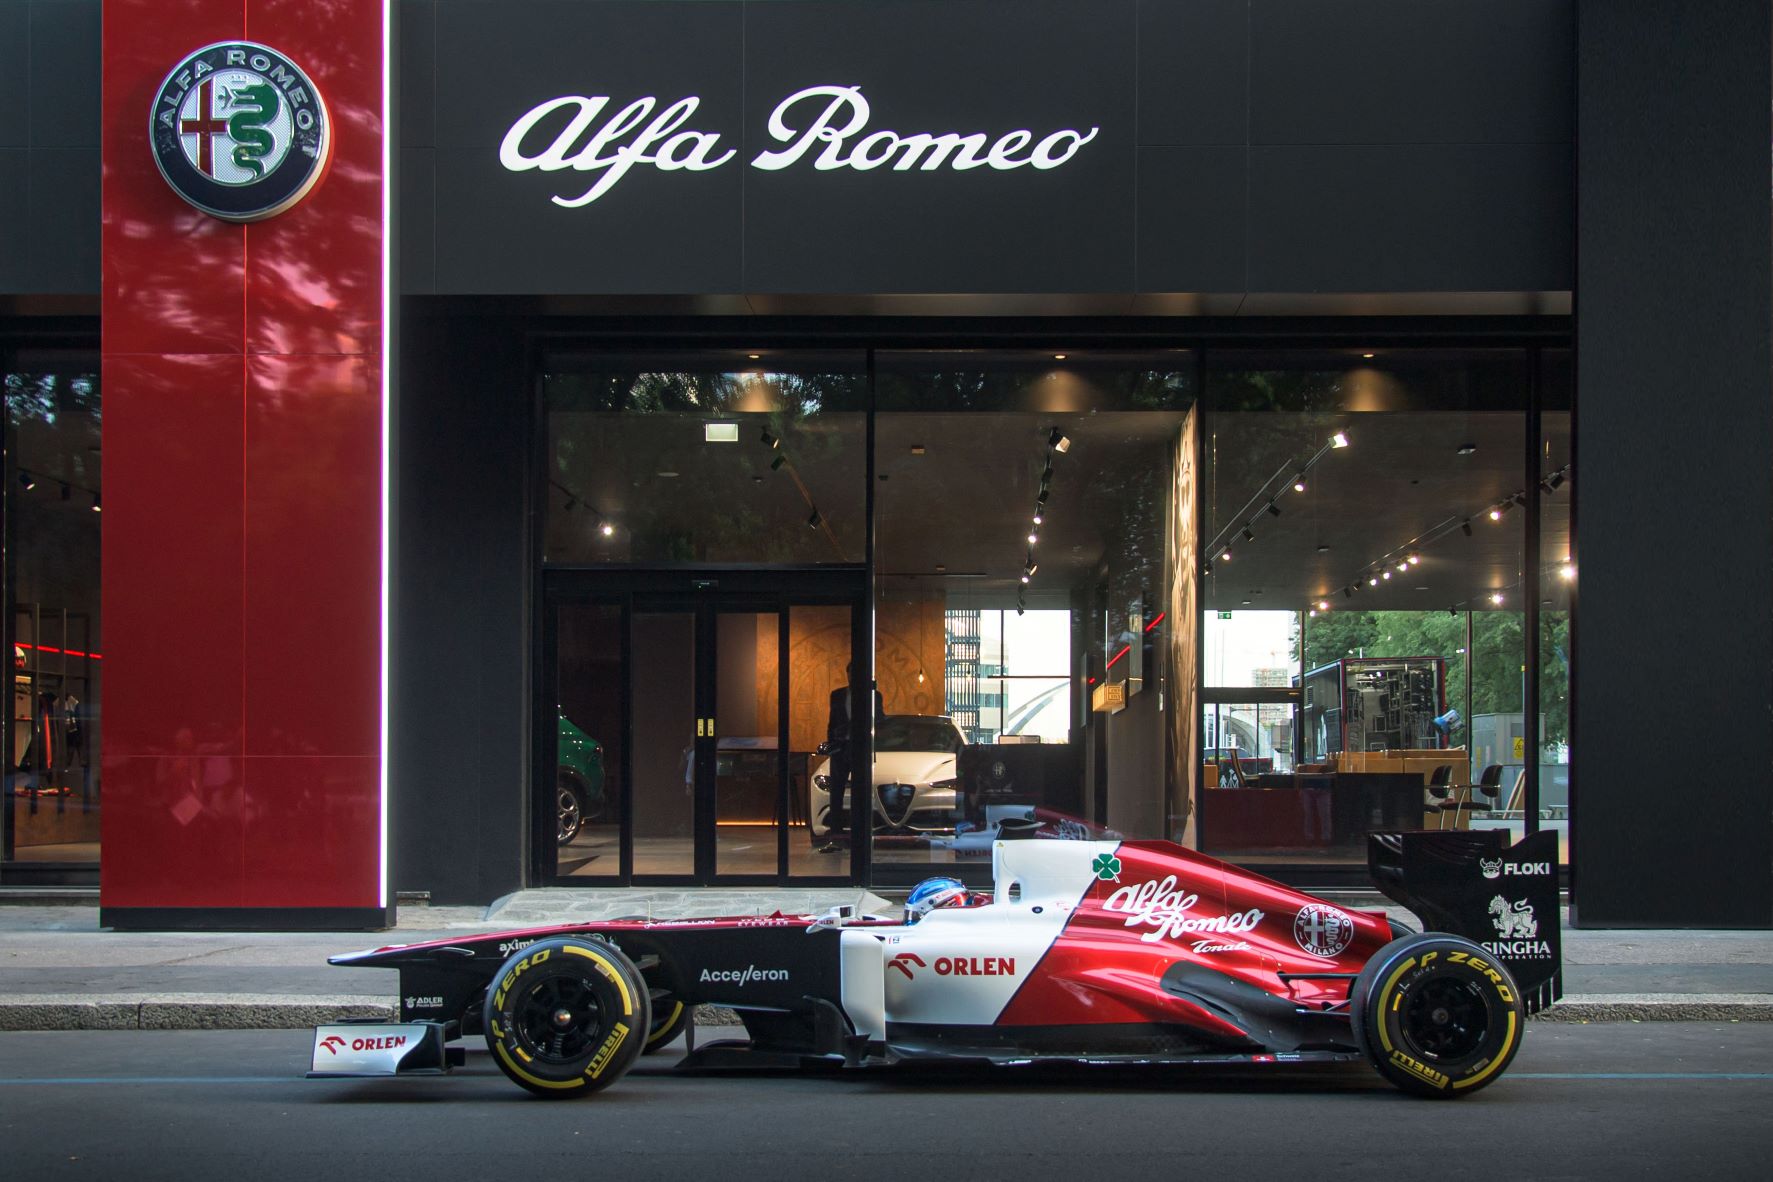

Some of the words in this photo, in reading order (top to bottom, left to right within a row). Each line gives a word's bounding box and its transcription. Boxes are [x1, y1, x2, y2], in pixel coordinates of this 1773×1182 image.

[160, 59, 213, 129] ALFA
[226, 49, 314, 130] ROMEO
[499, 95, 737, 208] Alfa
[751, 85, 1099, 171] Romeo
[1504, 862, 1550, 876] FLOKI
[1102, 874, 1187, 926] Alfa
[1140, 898, 1264, 942] Romeo
[1191, 939, 1251, 953] Tonale
[1305, 943, 1343, 956] MILANO
[1480, 941, 1551, 955] SINGHA
[494, 949, 551, 1011] ZERO
[700, 964, 789, 987] Accelleron
[934, 957, 1015, 976] ORLEN
[1420, 951, 1438, 968] P
[1446, 951, 1514, 1002] ZERO
[416, 996, 443, 1004] ADLER
[351, 1035, 407, 1051] ORLEN
[584, 1022, 630, 1079] PIRELLI
[1389, 1050, 1449, 1088] PIRELLI
